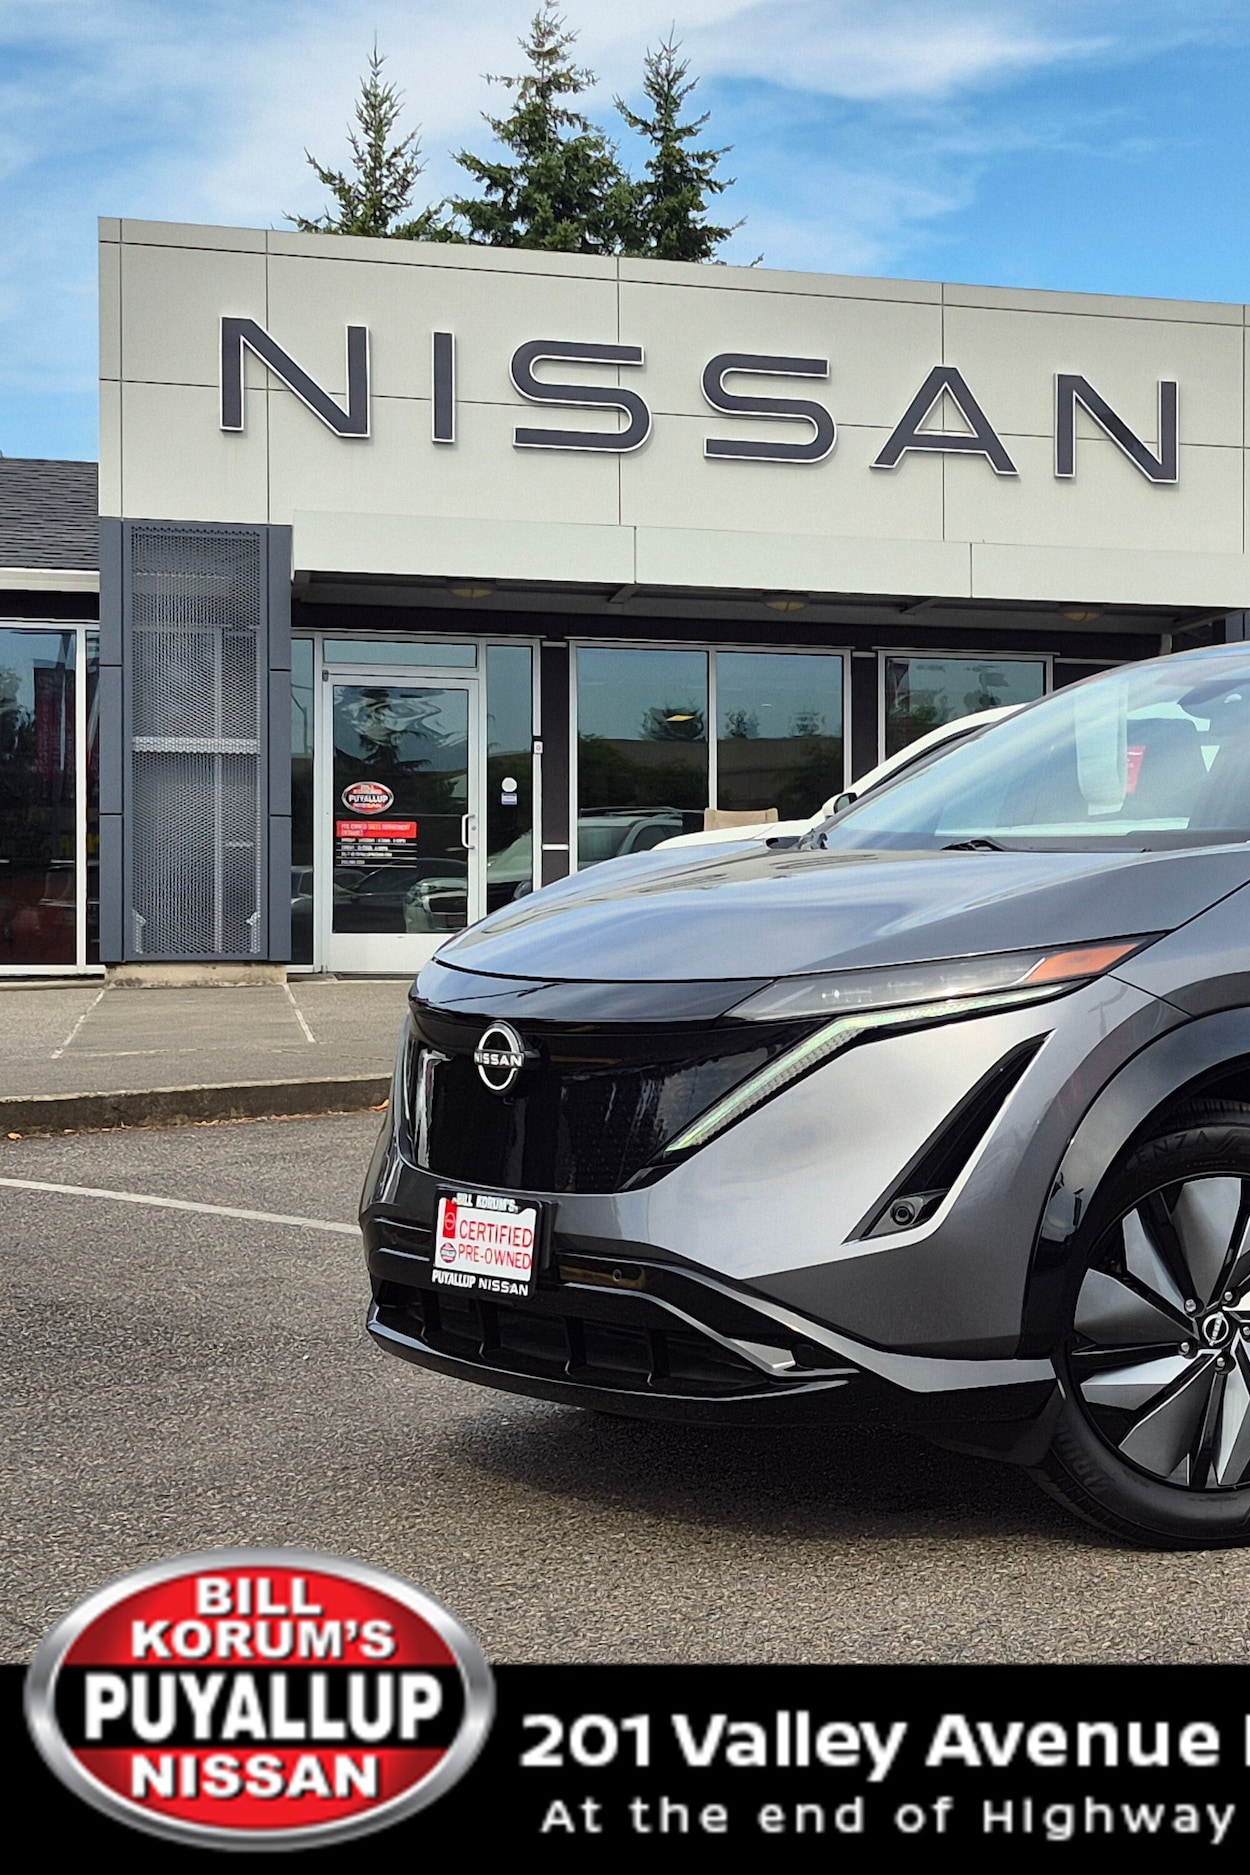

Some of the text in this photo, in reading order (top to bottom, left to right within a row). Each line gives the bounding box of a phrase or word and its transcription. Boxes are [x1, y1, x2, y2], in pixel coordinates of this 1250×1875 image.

[220, 316, 1179, 484] NISSAN
[348, 794, 389, 804] PUYALLUP
[474, 1051, 523, 1067] NISSAN
[459, 1219, 533, 1248] CERTIFIED
[458, 1243, 533, 1270] PRE-OWNED
[431, 1268, 530, 1297] PUYALLUP NISSAN
